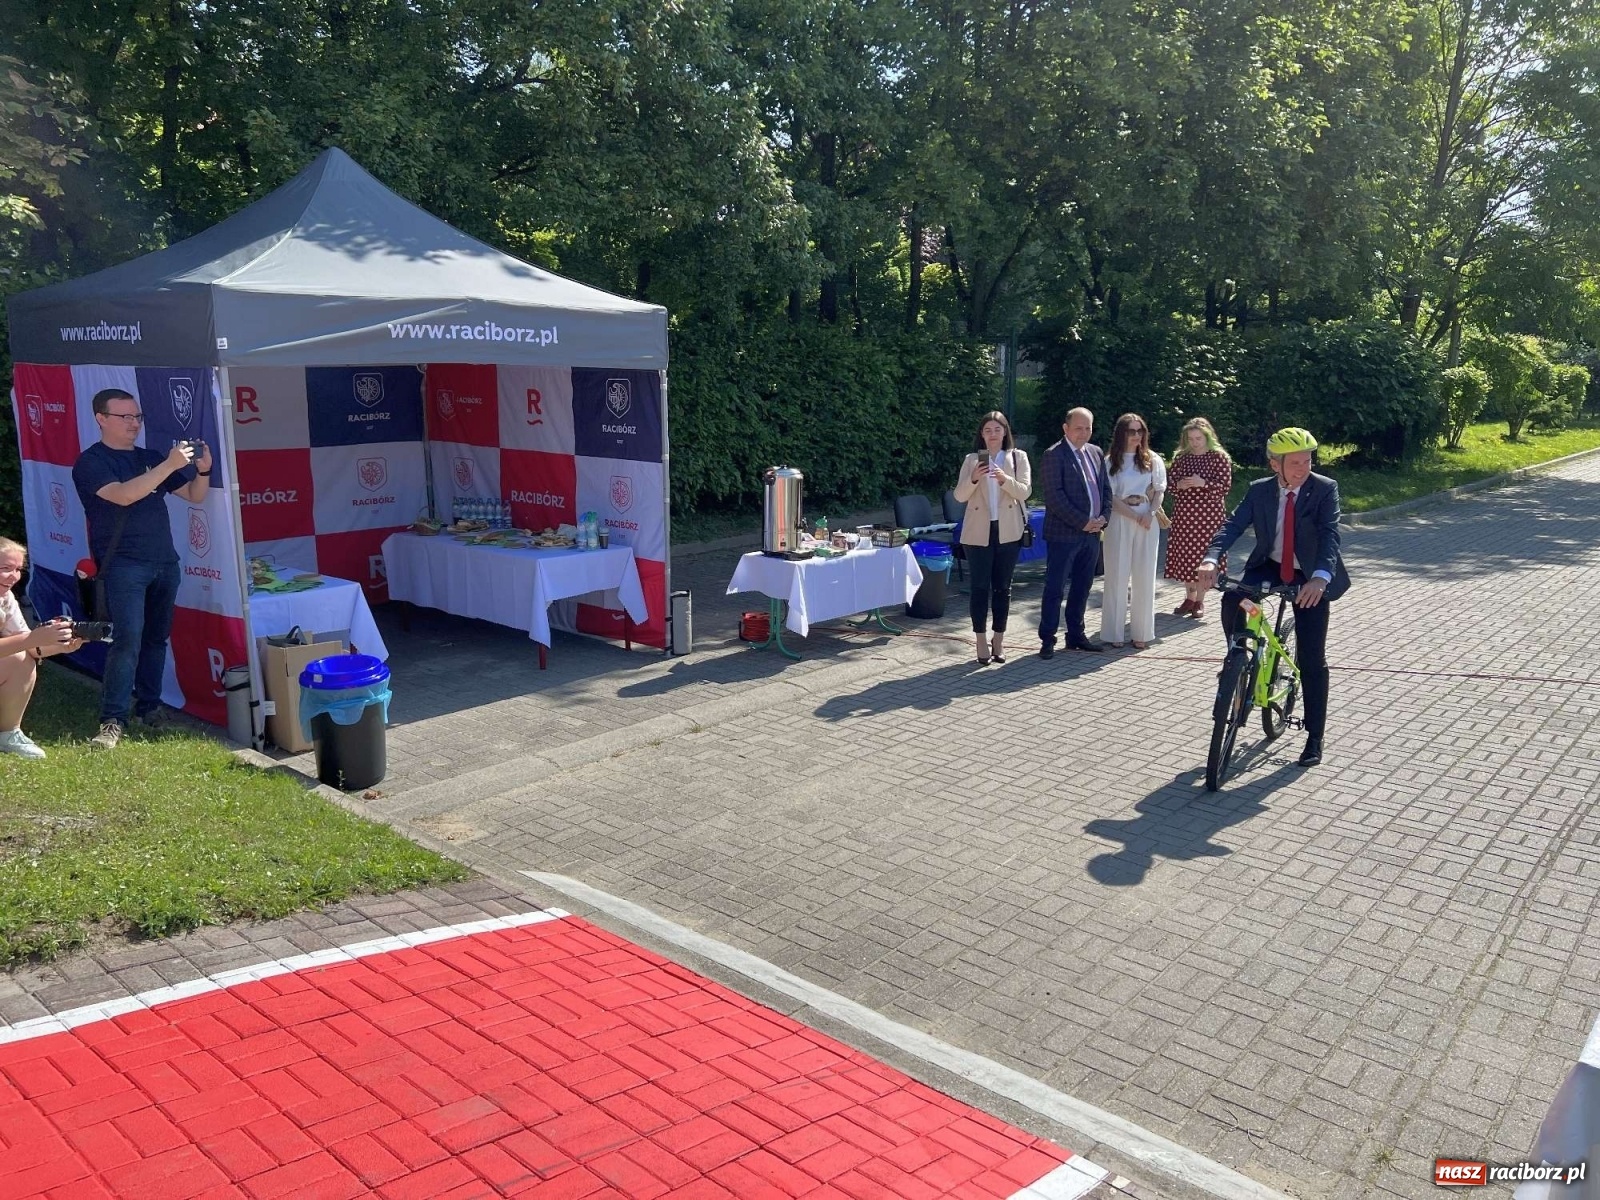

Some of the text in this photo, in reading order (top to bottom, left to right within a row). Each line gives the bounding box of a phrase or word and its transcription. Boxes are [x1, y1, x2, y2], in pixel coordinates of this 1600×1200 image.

[60, 320, 142, 344] www.raciborz.pl
[388, 321, 559, 347] www.raciborz.pl
[236, 387, 259, 412] R
[527, 389, 541, 414] R
[348, 411, 391, 422] RACIBÓRZ
[602, 423, 637, 435] RACIBÓRZ
[239, 487, 298, 505] CIBÓRZ
[511, 490, 565, 508] RACIBÓRZ
[604, 518, 639, 531] RACIBÓRZ
